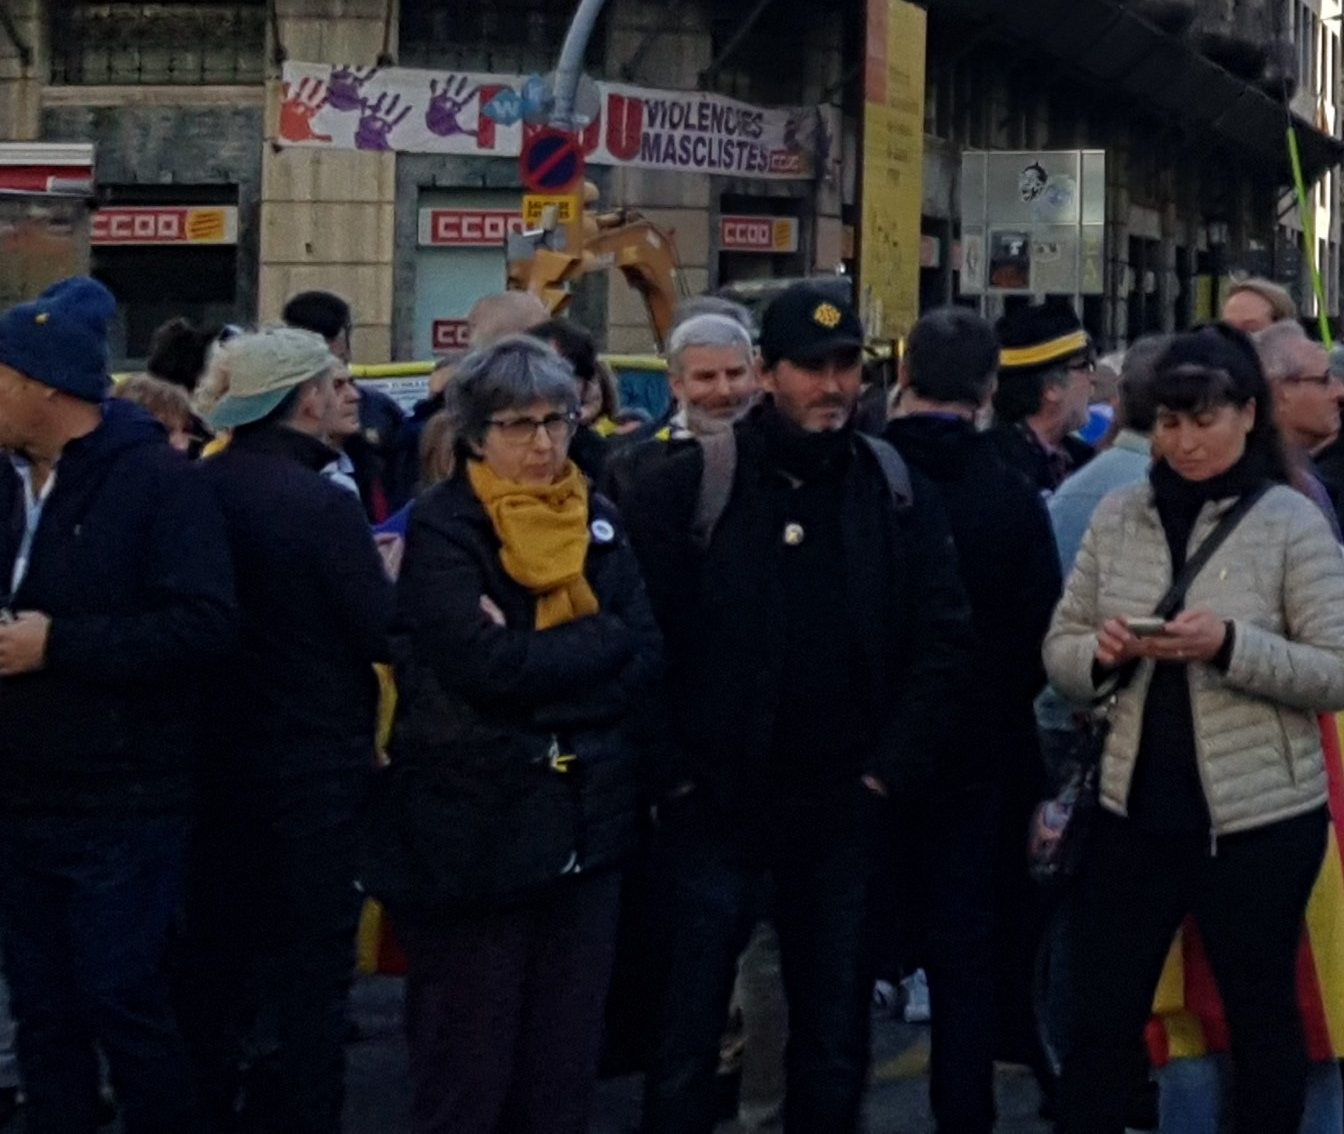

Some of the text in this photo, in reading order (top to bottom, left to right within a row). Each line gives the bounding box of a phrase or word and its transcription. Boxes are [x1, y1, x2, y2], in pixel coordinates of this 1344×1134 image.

[645, 98, 764, 139] VIOLENCIES
[641, 132, 768, 173] MASCLISTES
[91, 215, 179, 238] CCOO
[724, 223, 770, 244] CCOO
